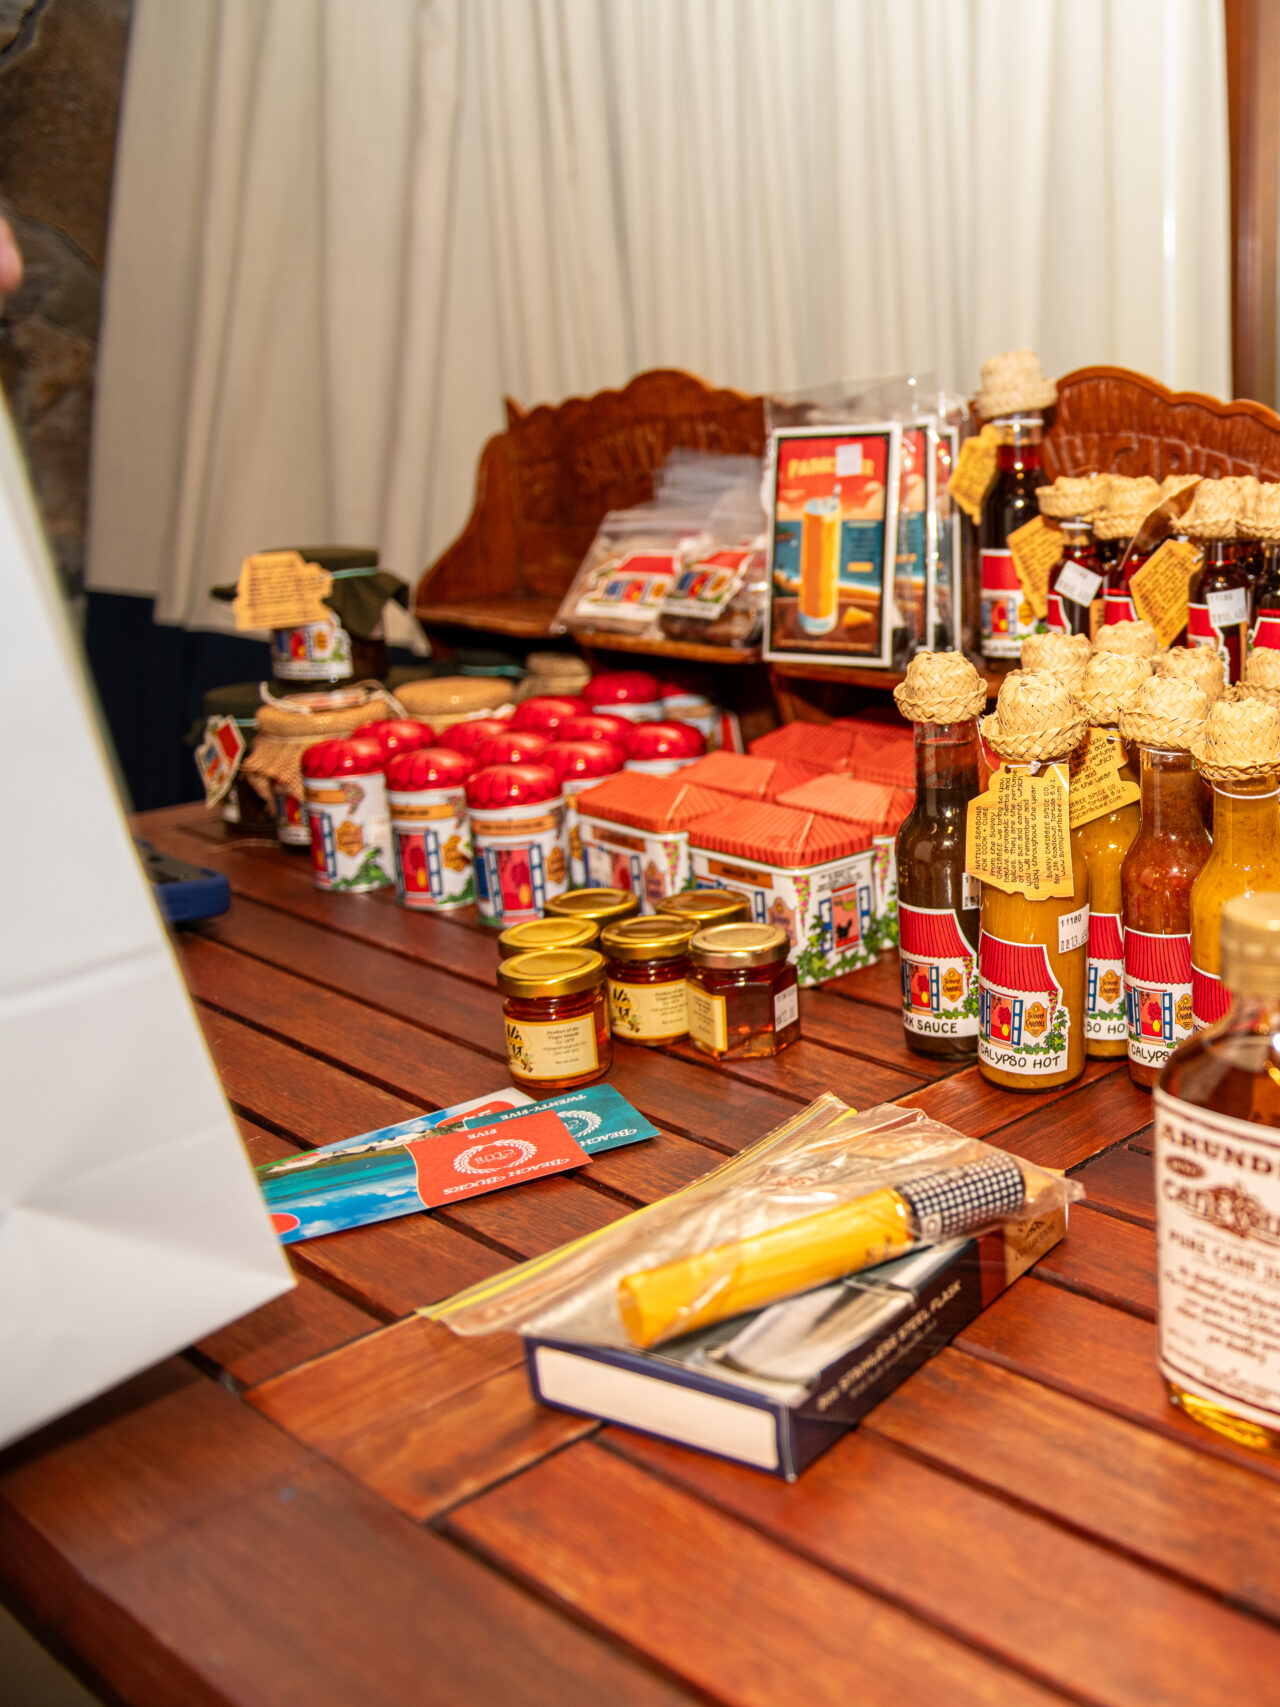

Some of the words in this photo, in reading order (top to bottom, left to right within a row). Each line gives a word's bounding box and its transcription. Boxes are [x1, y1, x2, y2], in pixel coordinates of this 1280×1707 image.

[998, 796, 1002, 804] to
[998, 829, 1002, 840] we
[1057, 786, 1066, 876] www.sunnycaribbee.com
[1030, 824, 1038, 866] throughout
[1017, 875, 1024, 883] of
[904, 1015, 914, 1028] RK
[918, 1021, 958, 1034] SAUCE
[980, 1044, 1027, 1067] CALYPSO
[1033, 1056, 1060, 1068] HOT
[500, 1093, 587, 1121] TWENTY-FIVE
[466, 1128, 498, 1140] FIVE
[580, 1128, 638, 1147] BEACH
[509, 1157, 571, 1178] BEACH
[443, 1174, 507, 1196] BUCKS
[929, 1278, 963, 1313] FLASK
